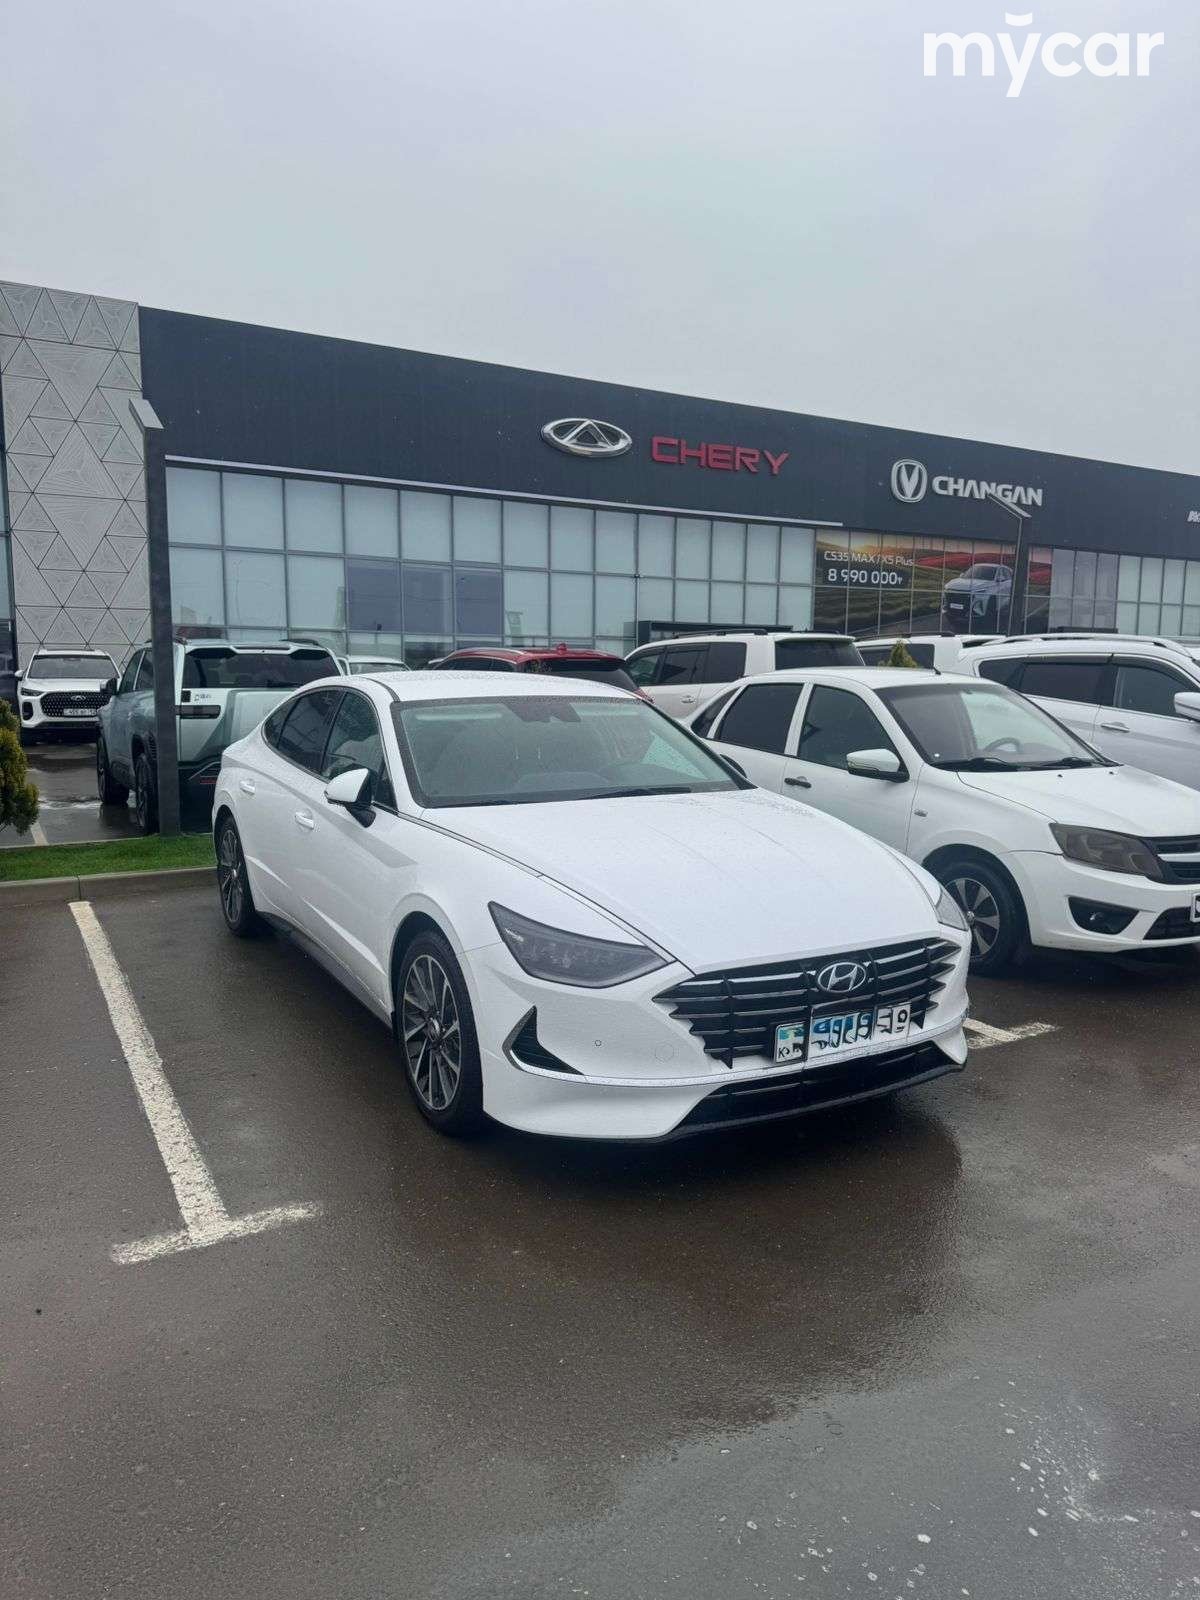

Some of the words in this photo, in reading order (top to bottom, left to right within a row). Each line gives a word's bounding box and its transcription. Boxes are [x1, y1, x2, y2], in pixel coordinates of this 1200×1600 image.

[651, 435, 790, 475] CHERY
[931, 475, 1043, 506] CHANGAN
[823, 550, 849, 561] CS35
[851, 552, 875, 563] MAX
[881, 556, 894, 565] X5
[895, 556, 914, 567] Plus
[828, 568, 837, 582] 8
[840, 569, 868, 583] 990
